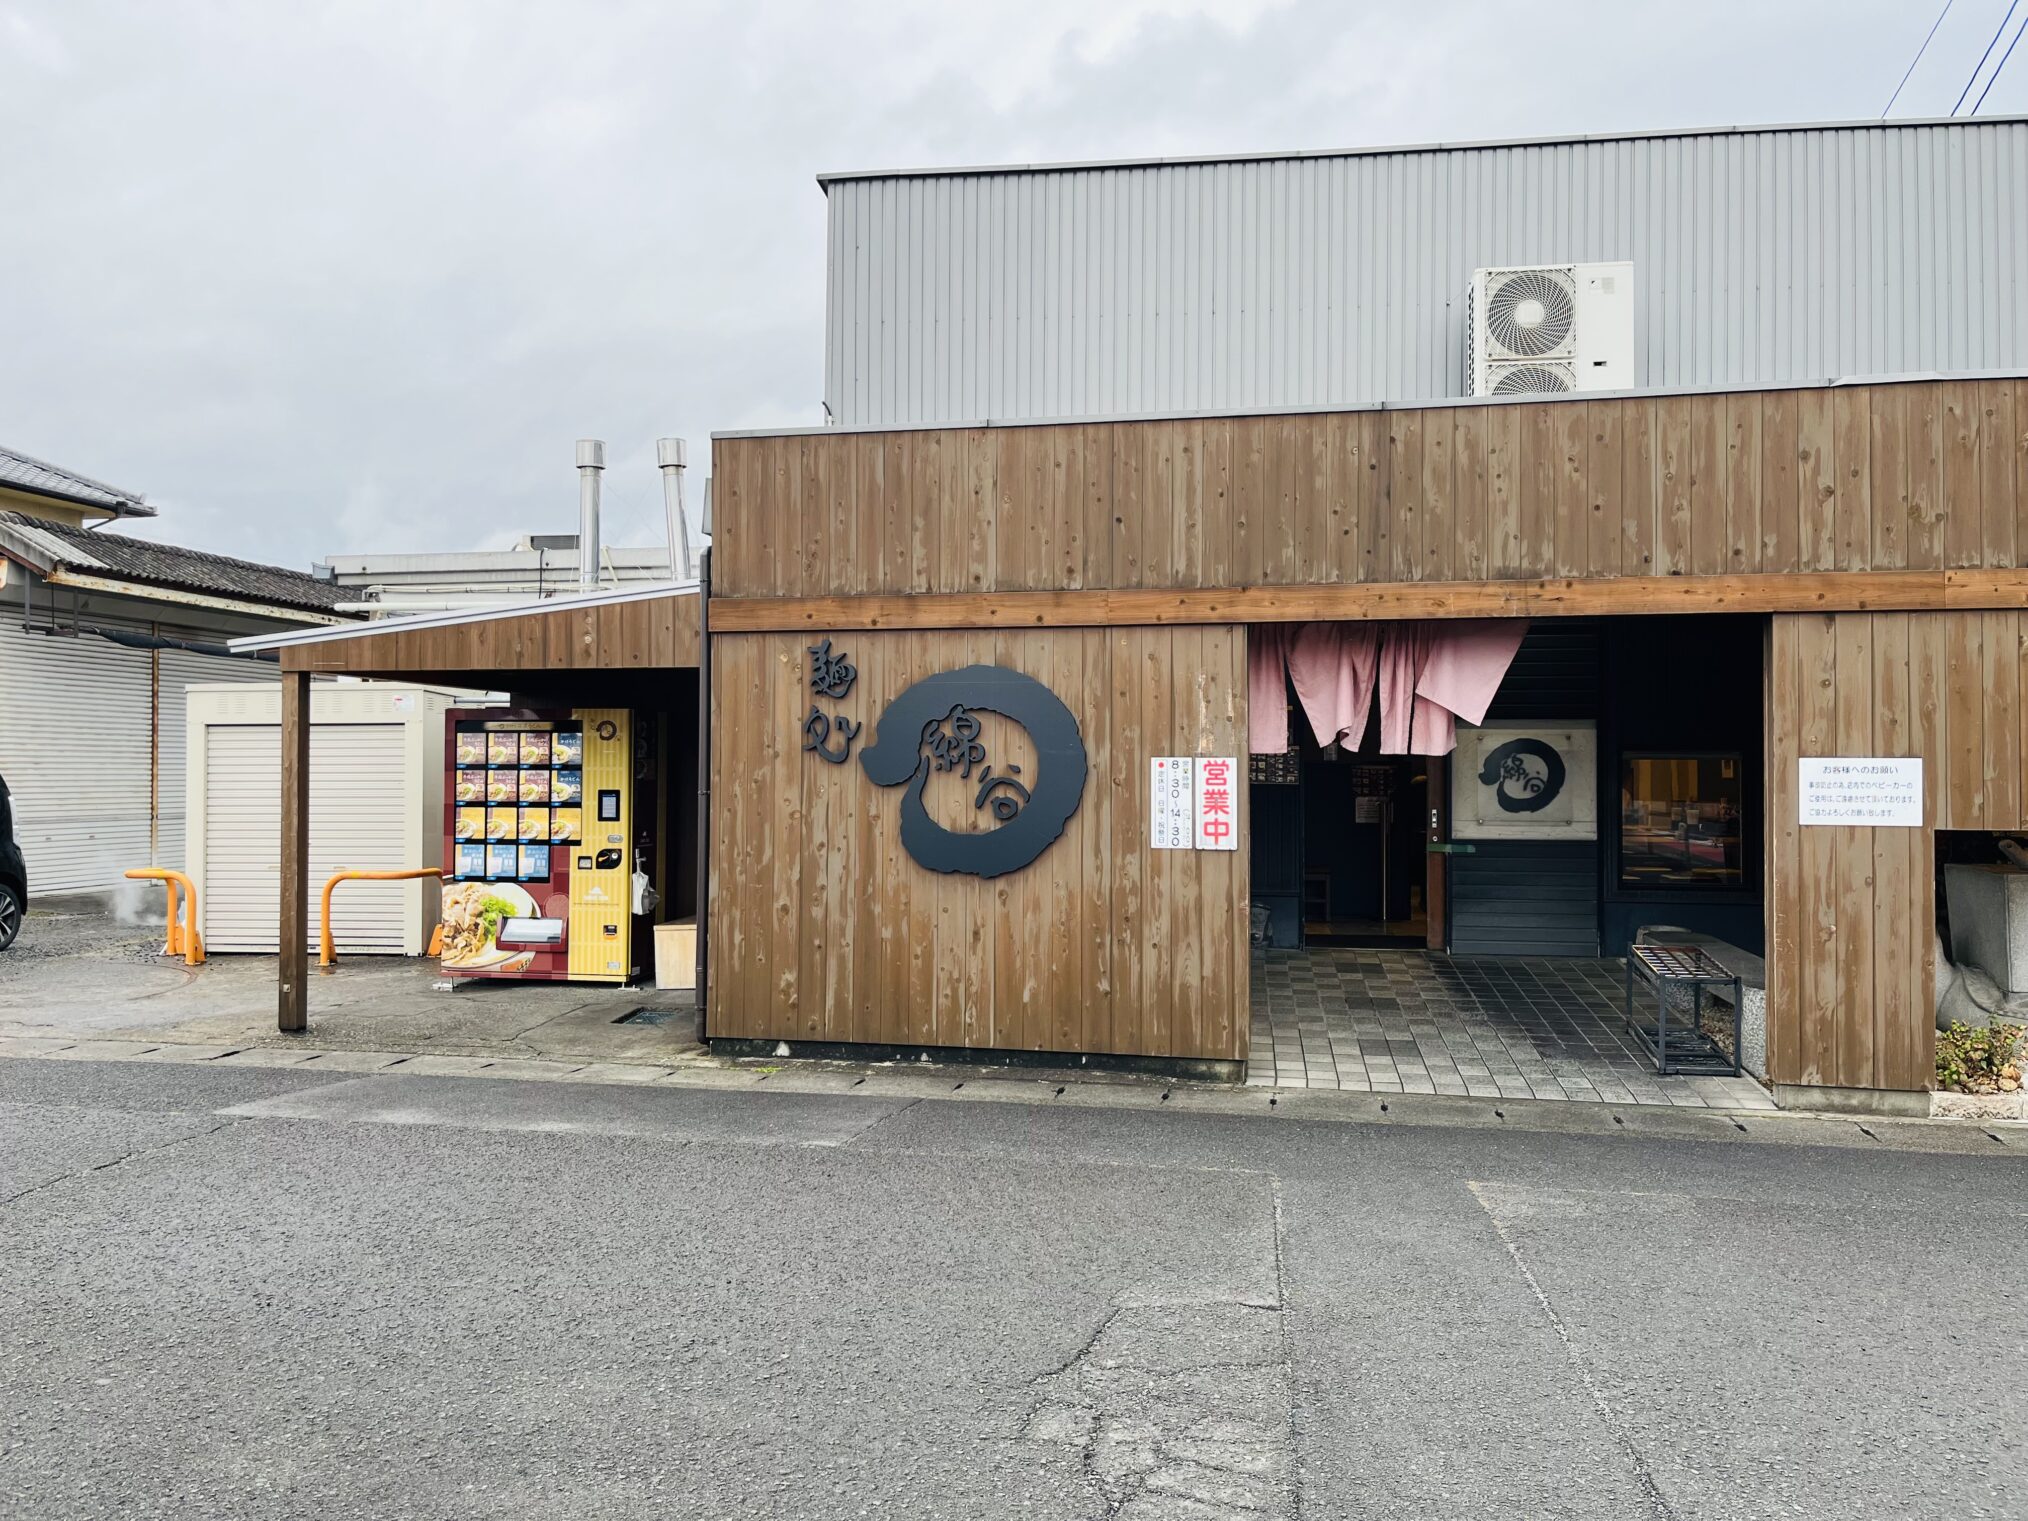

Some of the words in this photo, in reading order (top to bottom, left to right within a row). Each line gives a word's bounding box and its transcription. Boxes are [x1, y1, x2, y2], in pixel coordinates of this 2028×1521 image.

[1822, 765, 1899, 775] お客様へのお願い
[1203, 759, 1230, 845] 営業中
